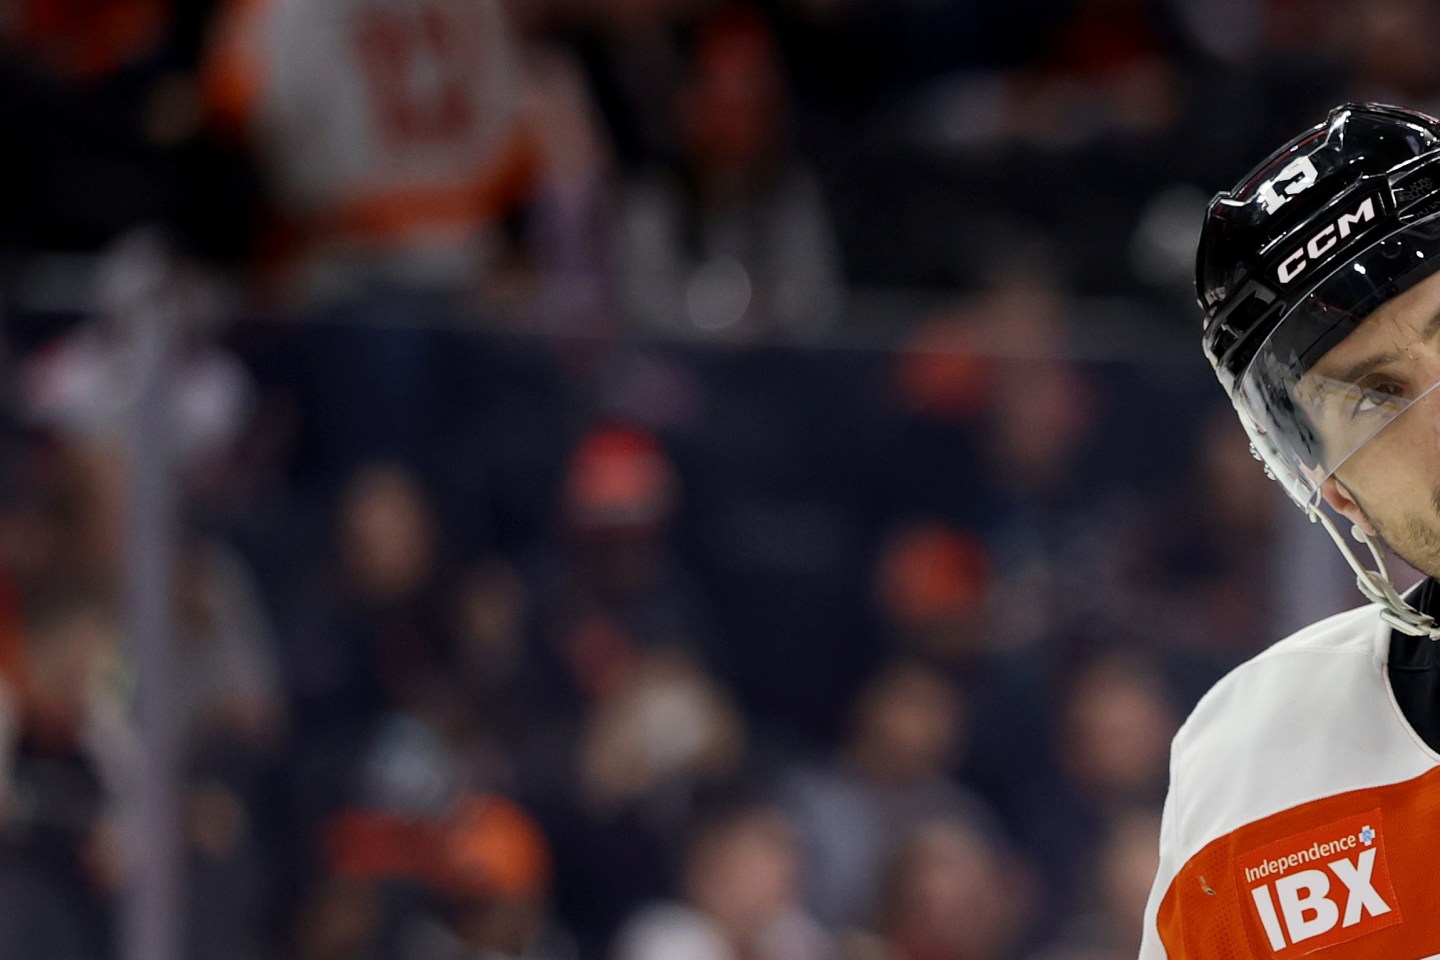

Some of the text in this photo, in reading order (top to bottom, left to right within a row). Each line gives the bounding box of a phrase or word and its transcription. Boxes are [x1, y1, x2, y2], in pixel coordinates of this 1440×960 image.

[1277, 197, 1376, 284] CCM
[1245, 834, 1357, 883] Independence
[1251, 847, 1392, 952] IBX
